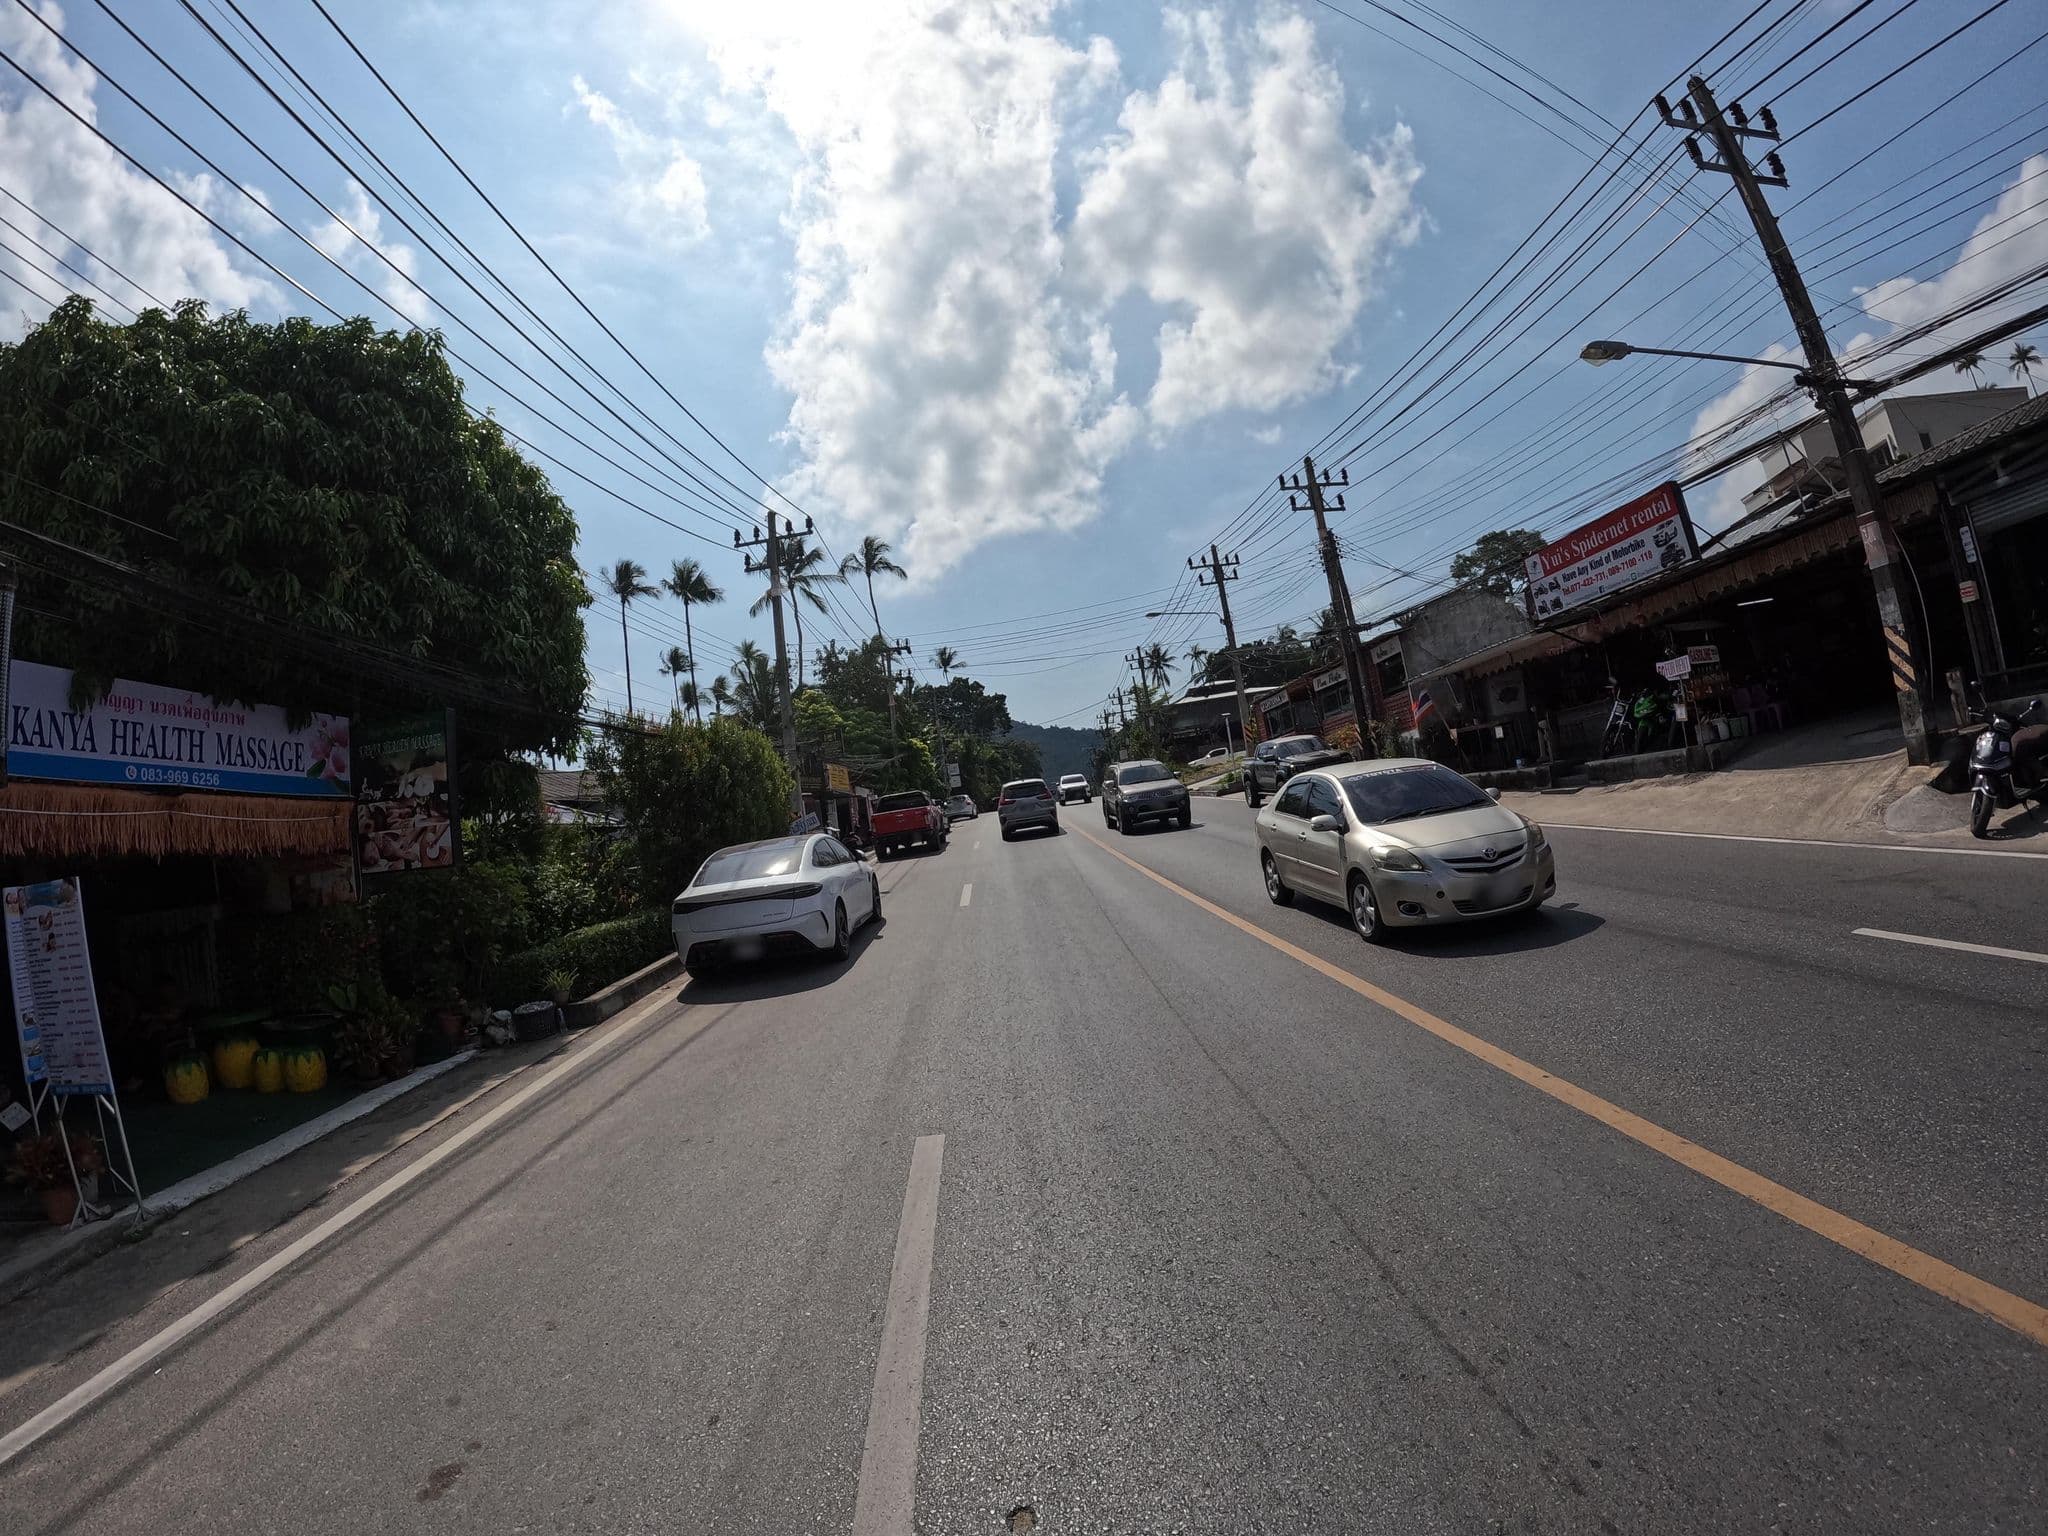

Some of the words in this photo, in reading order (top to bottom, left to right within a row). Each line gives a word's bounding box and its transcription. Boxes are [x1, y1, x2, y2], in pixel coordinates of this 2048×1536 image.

[1541, 546, 1571, 571] Yui's
[1571, 518, 1629, 559] Spidernet
[1631, 492, 1672, 528] rental
[1562, 570, 1577, 583] Have
[1577, 565, 1590, 577] Any
[1589, 556, 1604, 571] Kind
[1604, 553, 1612, 564] of
[1611, 538, 1646, 562] Motorbike
[100, 693, 143, 715] กญญา
[11, 705, 98, 753] KANYA
[110, 719, 204, 764] HEALTH
[216, 732, 306, 773] MASSAGE
[141, 767, 189, 784] 083-969
[192, 771, 220, 786] 6256
